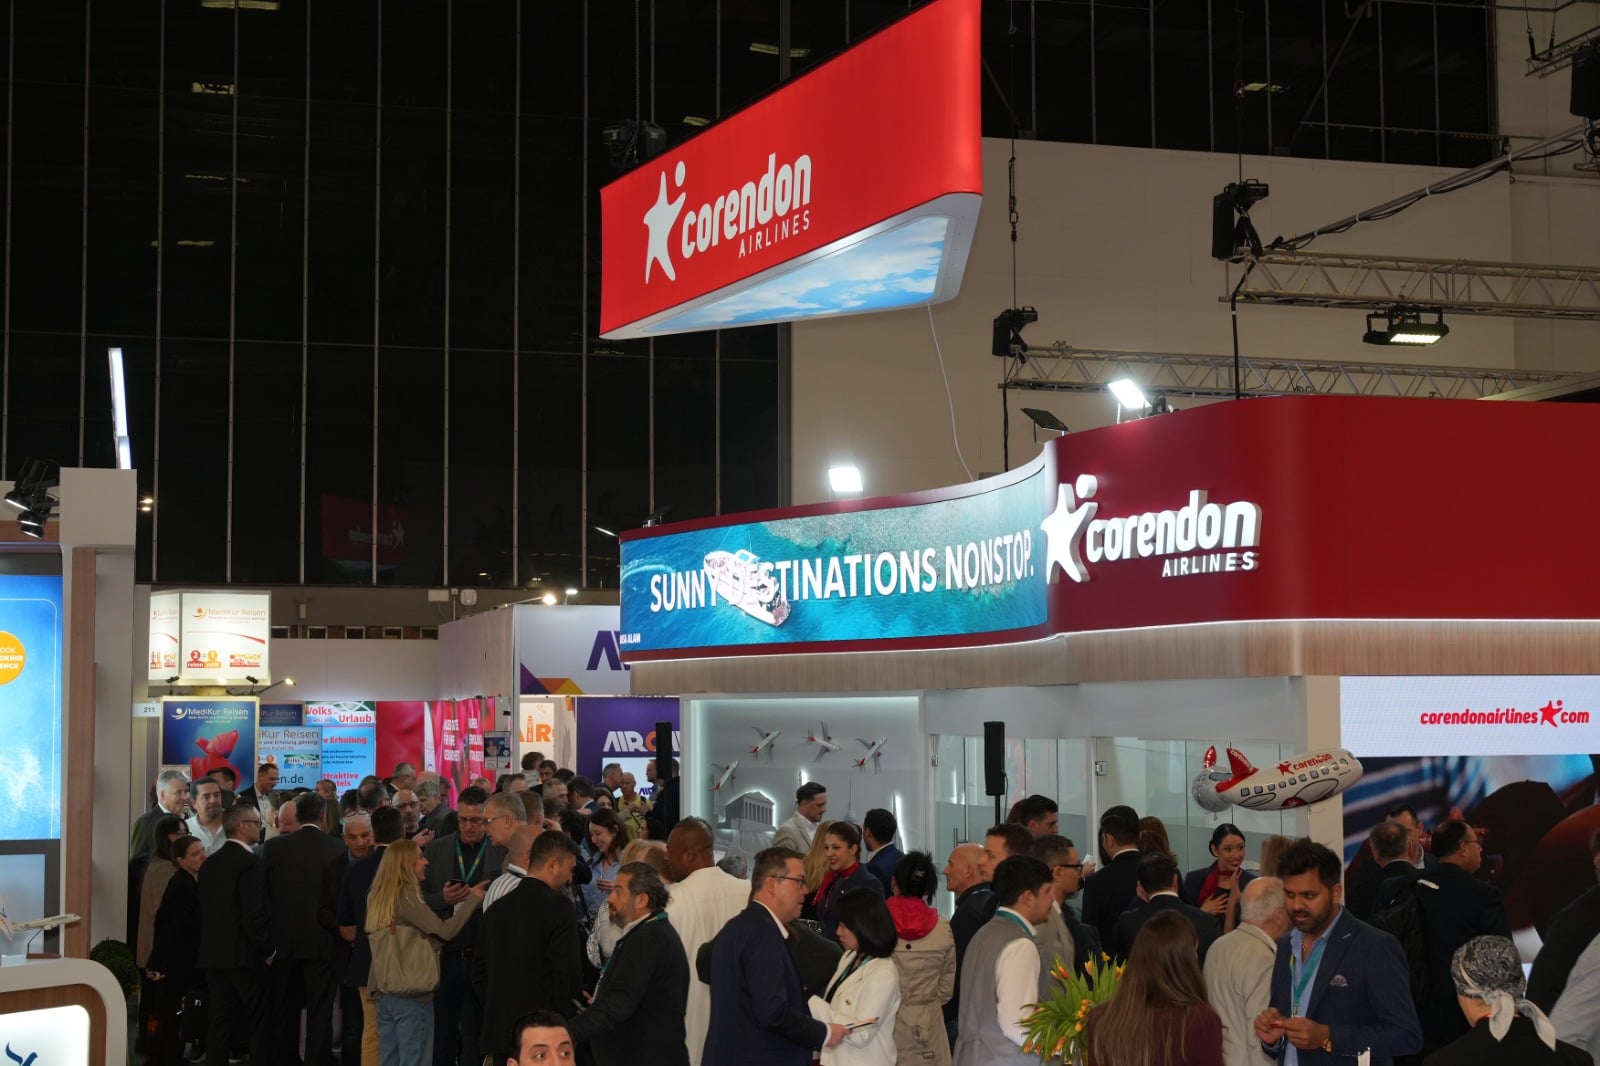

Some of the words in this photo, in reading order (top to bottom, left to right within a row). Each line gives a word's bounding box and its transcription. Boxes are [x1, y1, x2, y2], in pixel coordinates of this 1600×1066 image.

[682, 152, 812, 259] corendon
[739, 210, 810, 258] AIRLINES
[1086, 489, 1260, 563] corendon
[650, 566, 720, 612] SUNNY
[945, 529, 1034, 590] NONSTOP.
[1162, 551, 1258, 577] AIRLINES
[188, 707, 220, 716] MediKur
[223, 708, 249, 716] Reisen
[339, 713, 372, 723] Urlaub
[1420, 707, 1538, 725] corendonairlines
[1560, 711, 1590, 724] com
[283, 729, 319, 739] Reisen
[330, 736, 368, 745] Erholung
